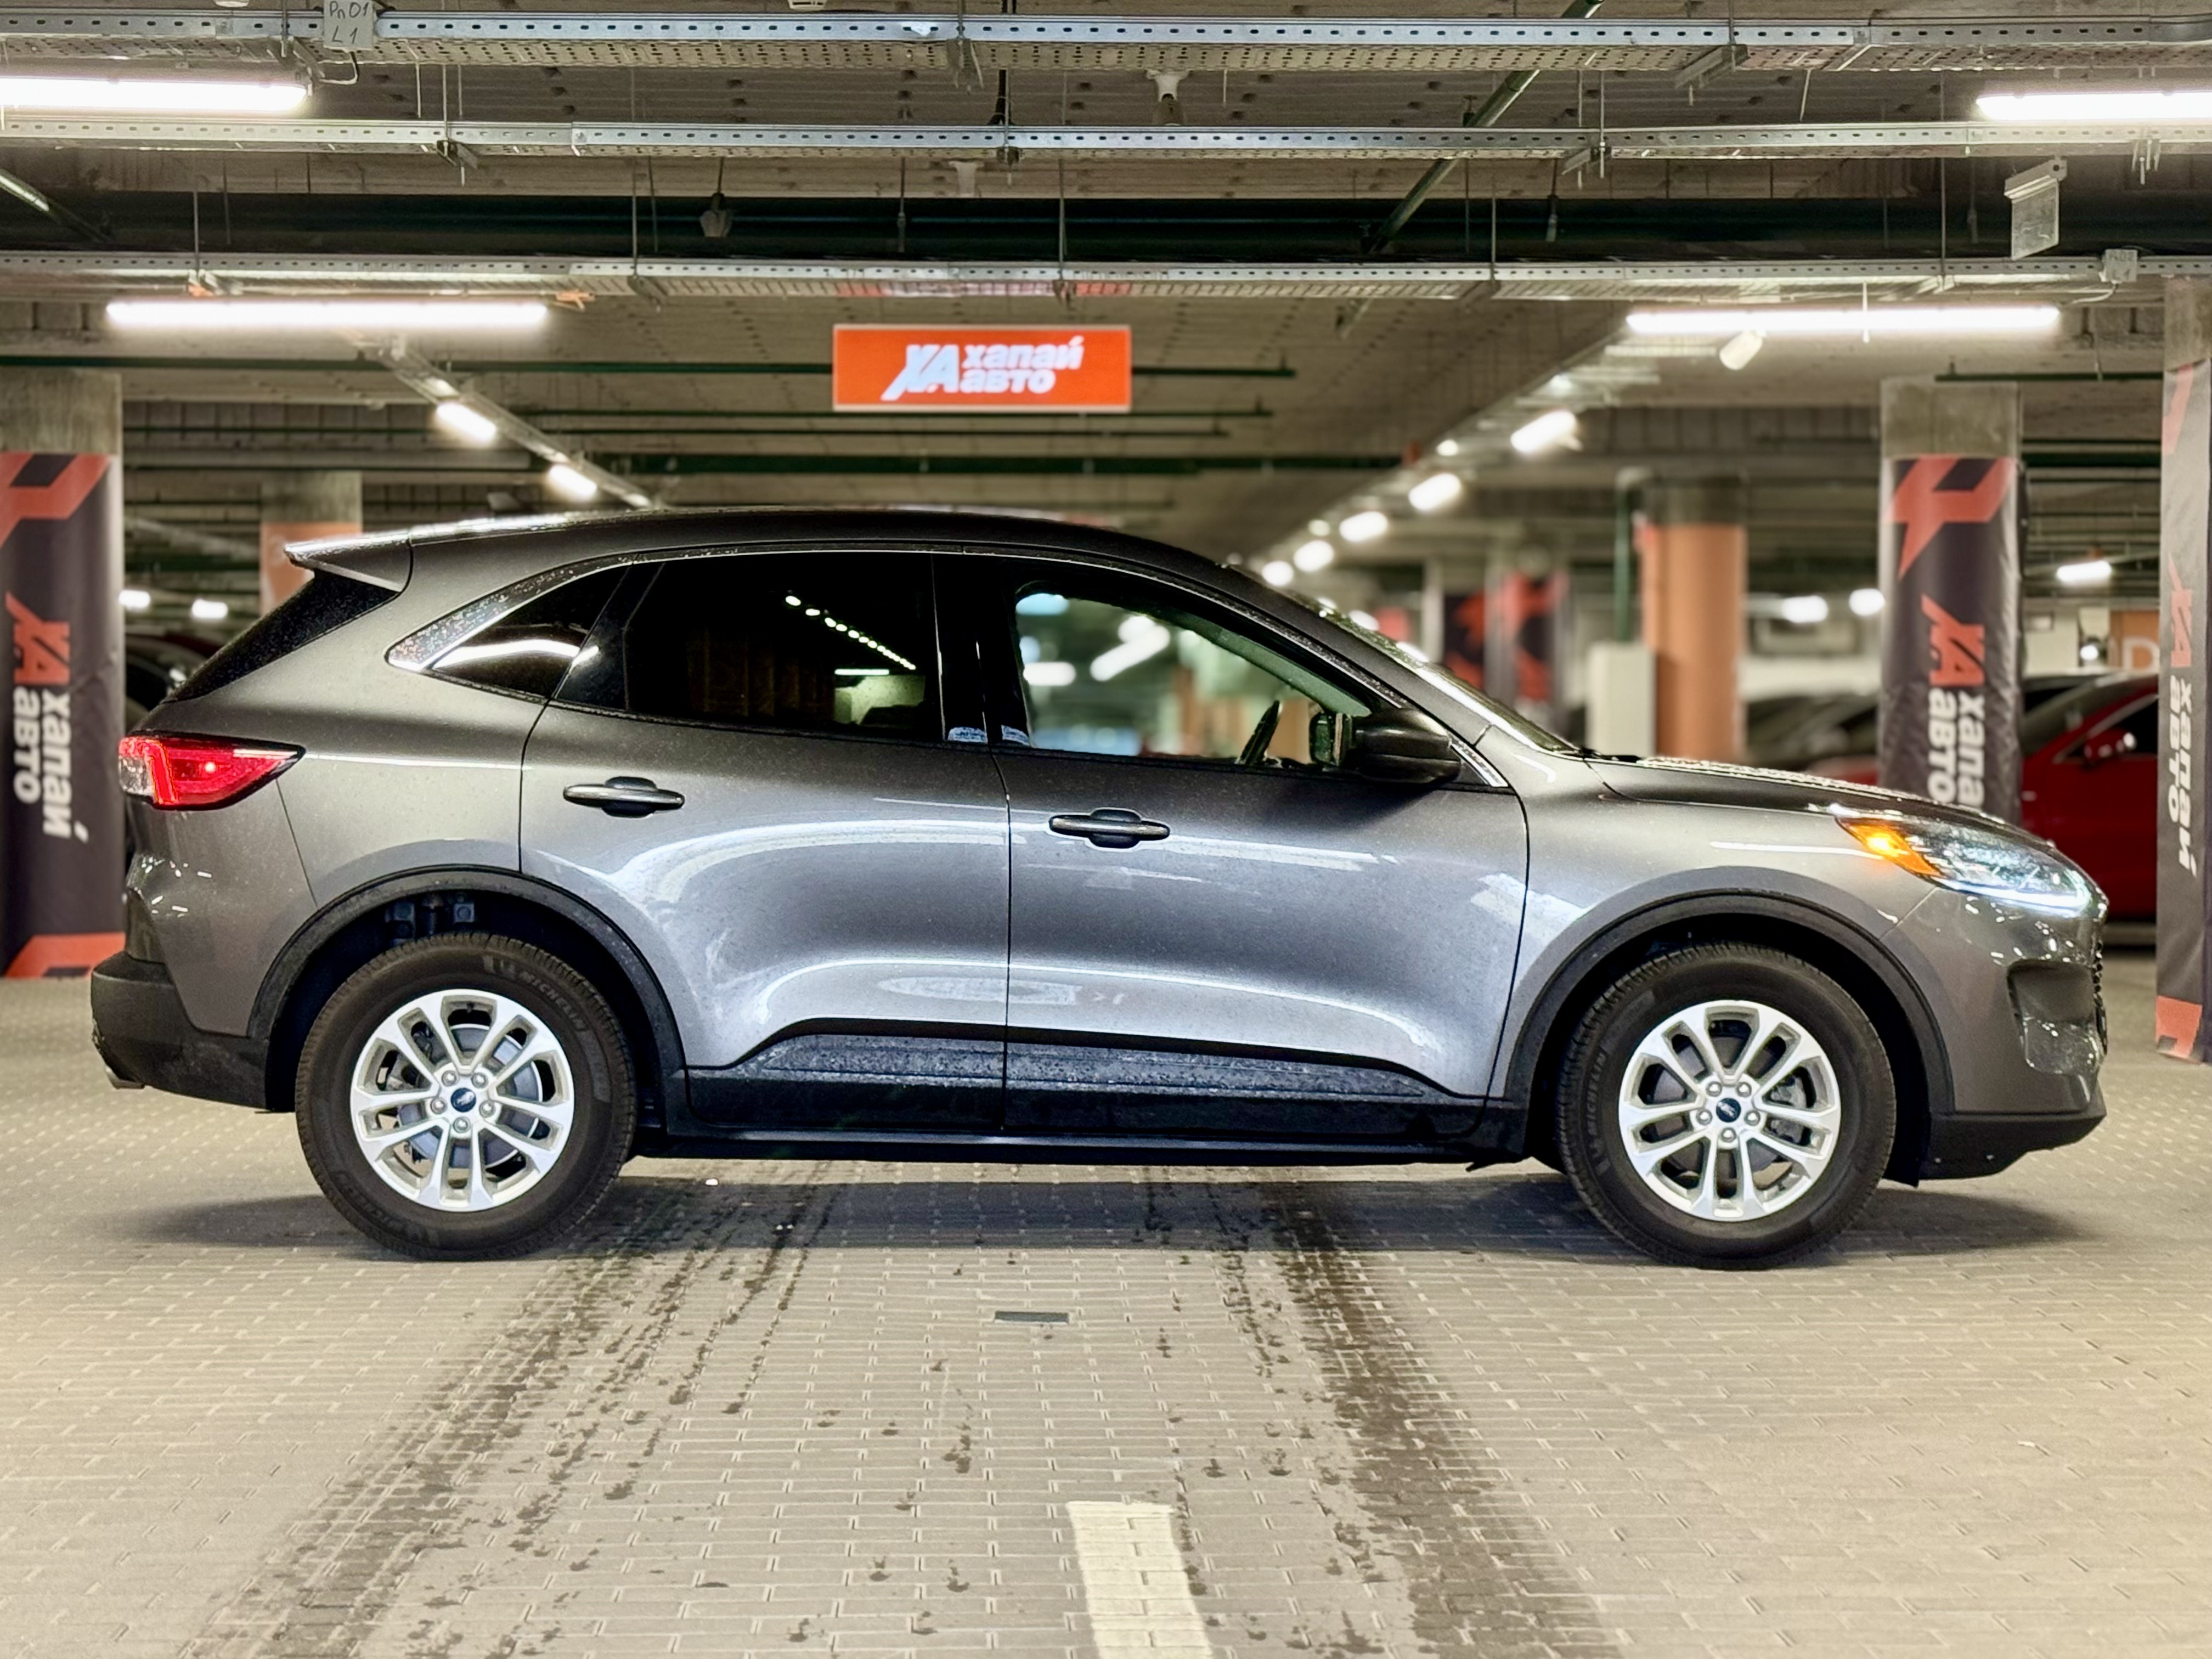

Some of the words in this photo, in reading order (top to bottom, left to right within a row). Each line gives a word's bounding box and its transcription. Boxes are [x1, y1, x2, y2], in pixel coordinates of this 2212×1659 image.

[960, 369, 1056, 393] авто
[962, 335, 1085, 369] хапай
[13, 686, 41, 804] авто
[42, 689, 89, 842] хапай
[1927, 687, 1957, 803] авто
[1957, 690, 1985, 806] хапа
[2168, 675, 2181, 823] авто
[2179, 678, 2197, 878] хапай
